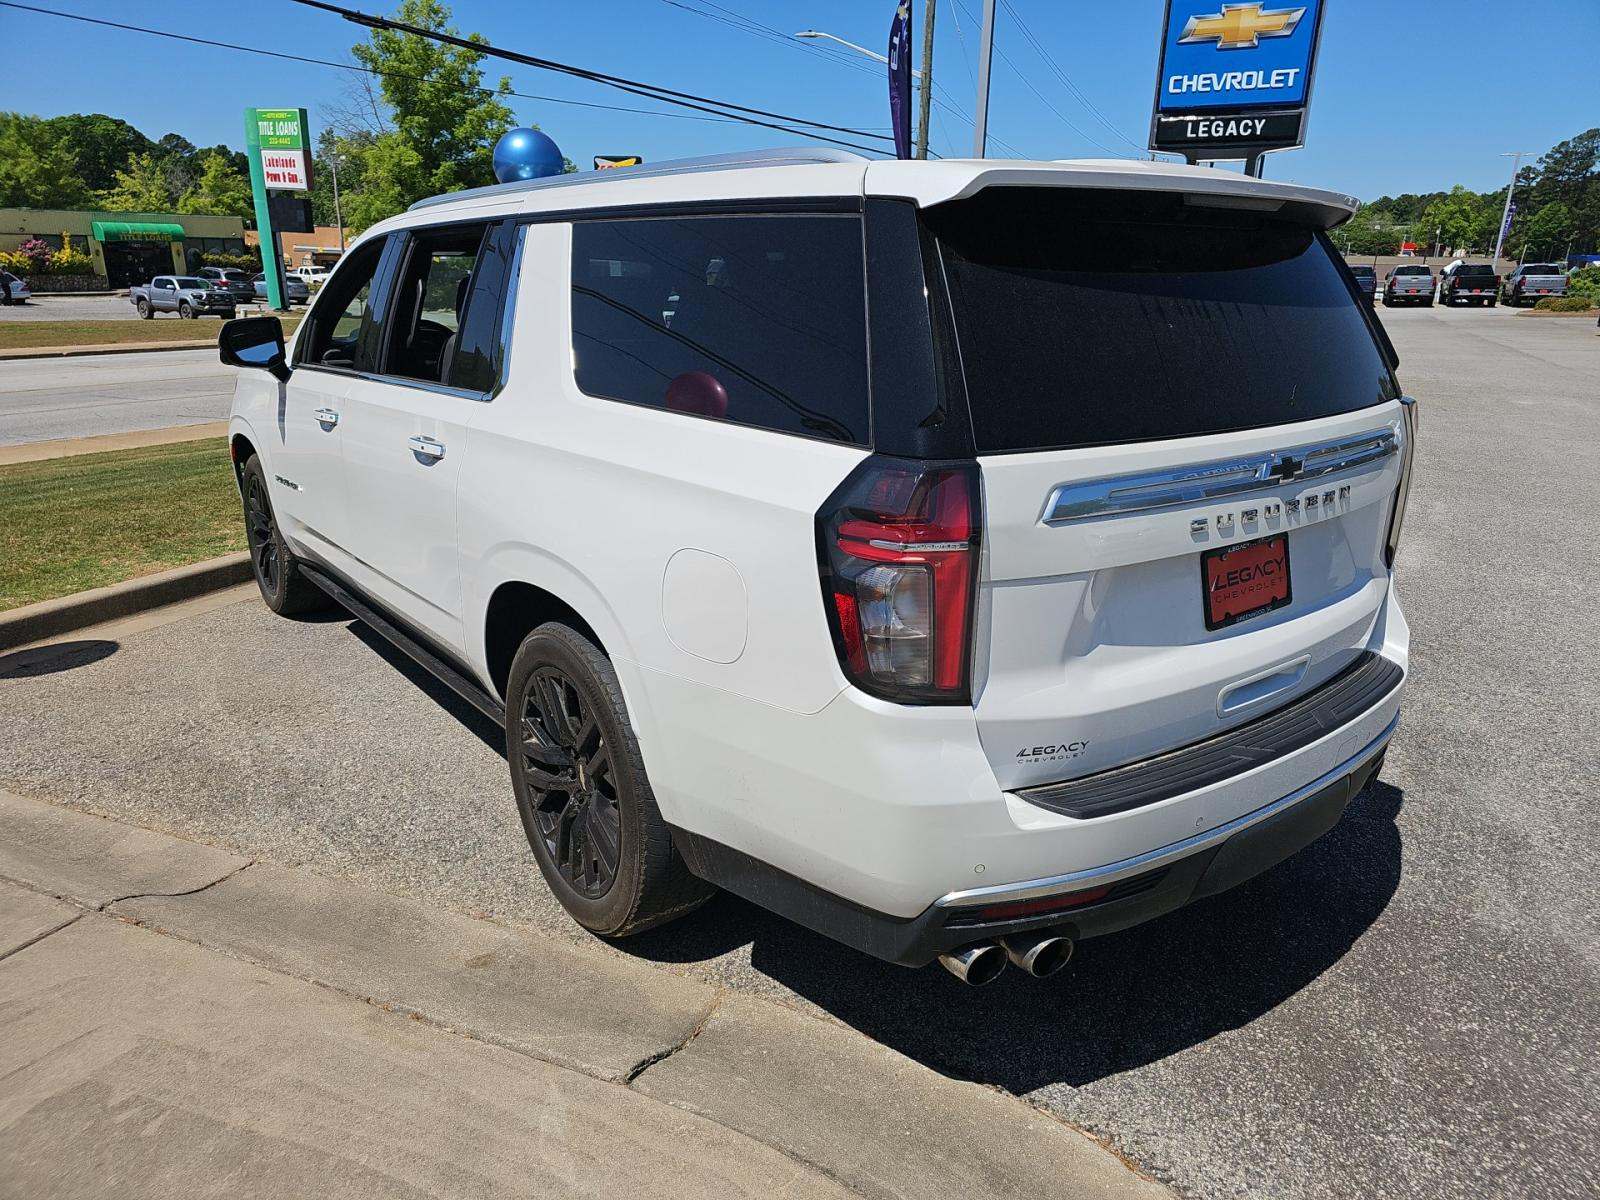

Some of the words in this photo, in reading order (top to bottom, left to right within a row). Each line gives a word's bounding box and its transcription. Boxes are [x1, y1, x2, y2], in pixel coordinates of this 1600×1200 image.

[1168, 68, 1300, 94] CHEVROLET
[258, 121, 274, 135] TITLE
[276, 121, 298, 136] LOANS
[1186, 118, 1266, 138] LEGACY
[1190, 485, 1351, 533] SUBURBAN
[1211, 556, 1284, 592] LEGACY
[1214, 577, 1284, 604] CHEVROLET
[1016, 740, 1090, 758] LEGACY
[1017, 752, 1086, 764] CHEVROLET
